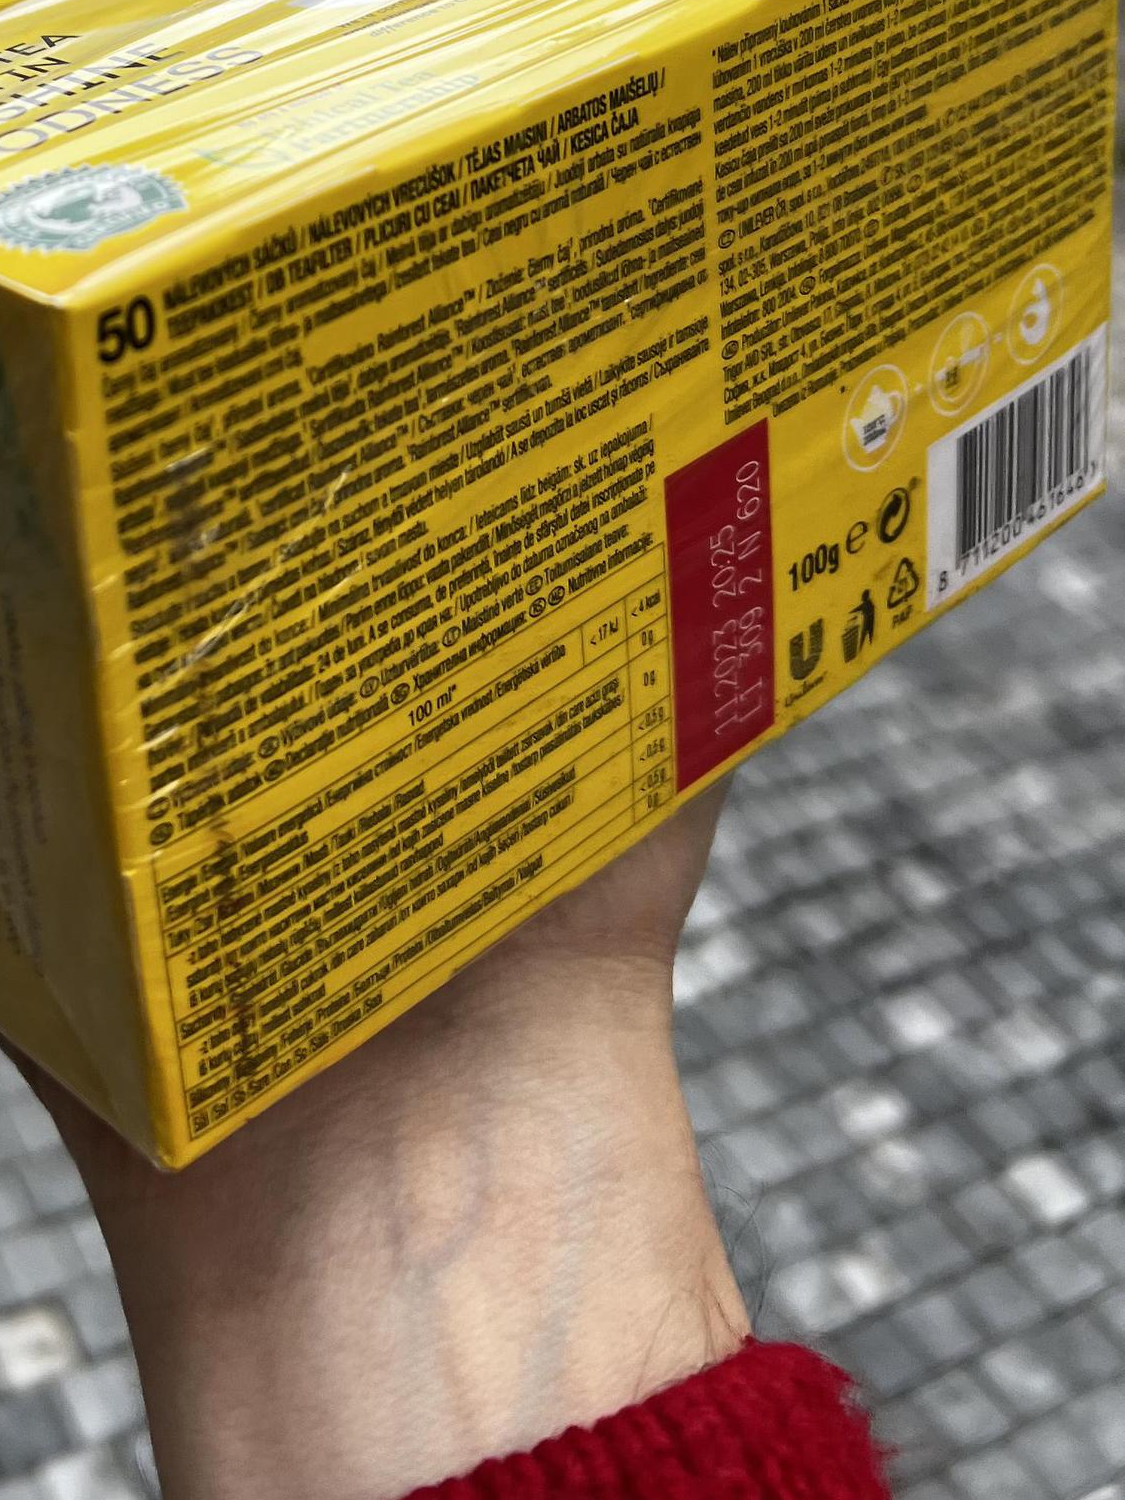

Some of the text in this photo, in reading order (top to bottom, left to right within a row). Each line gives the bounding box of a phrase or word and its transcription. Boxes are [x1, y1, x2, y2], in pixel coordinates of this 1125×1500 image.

[0, 54, 79, 84] IN
[251, 226, 297, 270] SÁČKŮ
[308, 191, 390, 244] NÁLEVOVÝCH
[391, 161, 455, 207] VRECÚŠOK
[557, 93, 606, 134] ARBATOS
[608, 70, 658, 115] MAIŠELIŲ
[287, 236, 353, 283] TEAFILTER
[362, 210, 412, 250] PLICURI
[413, 200, 431, 228] CU
[432, 187, 461, 218] CEAI
[470, 154, 535, 201] ПАКЕТЧЕТА
[536, 137, 561, 169] ЧАЙ
[569, 119, 609, 156] KESICA
[610, 106, 639, 137] ČAJA
[96, 294, 155, 365] 50
[510, 562, 521, 581] do
[599, 509, 610, 527] na
[737, 529, 762, 562] N
[788, 542, 840, 591] 100g
[738, 566, 763, 597] 2
[408, 698, 433, 727] 100
